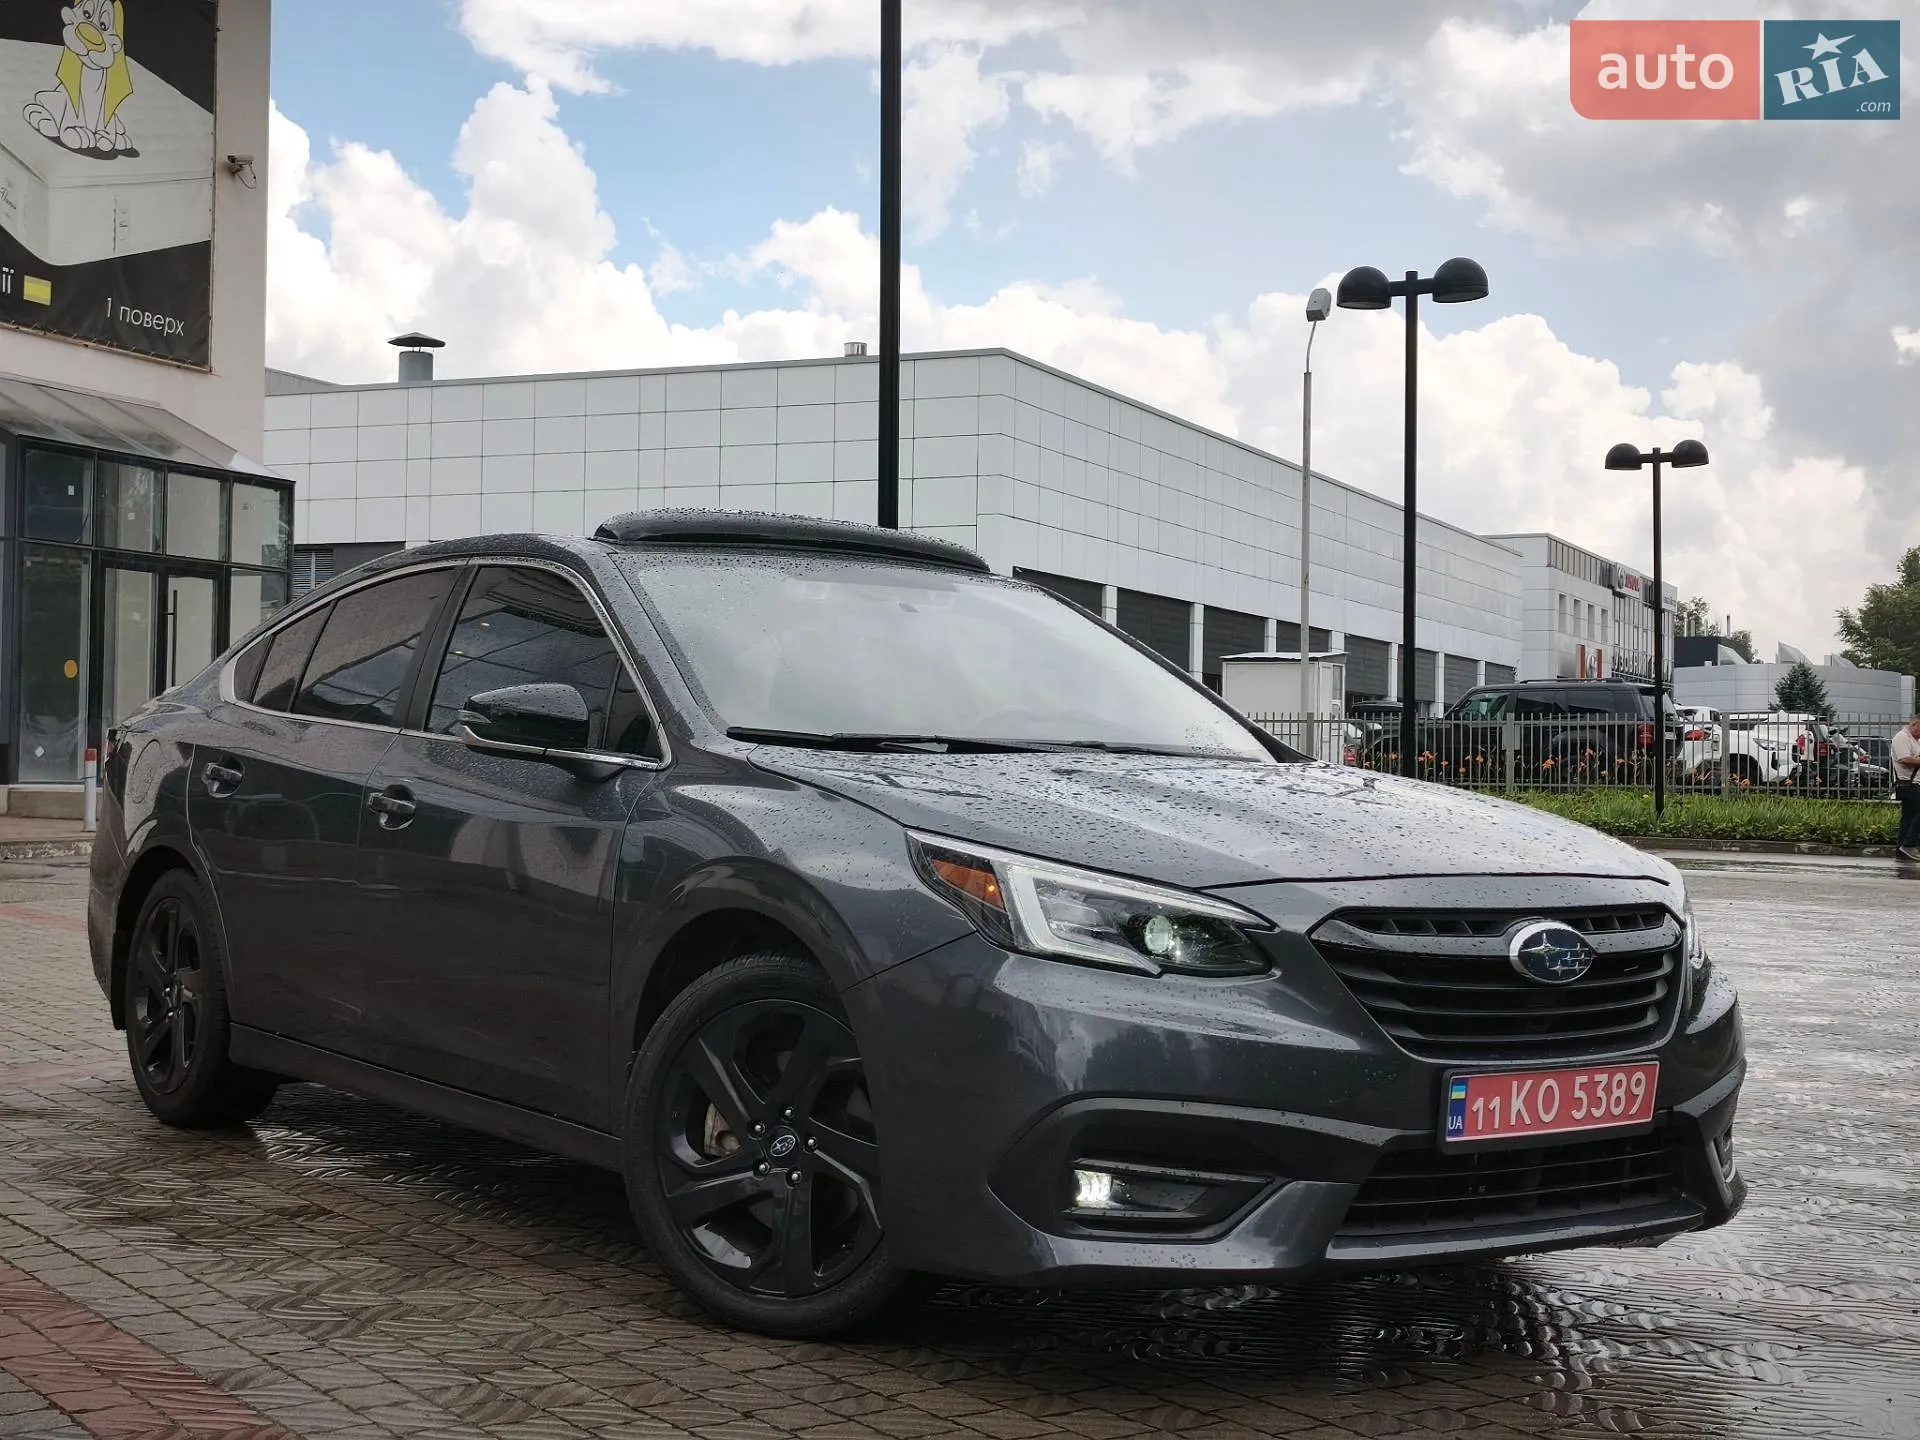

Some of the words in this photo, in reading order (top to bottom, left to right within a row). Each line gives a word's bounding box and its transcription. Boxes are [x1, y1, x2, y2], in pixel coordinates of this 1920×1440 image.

[119, 305, 185, 337] поверх
[1571, 1071, 1647, 1120] 5389
[1448, 1115, 1463, 1130] UA
